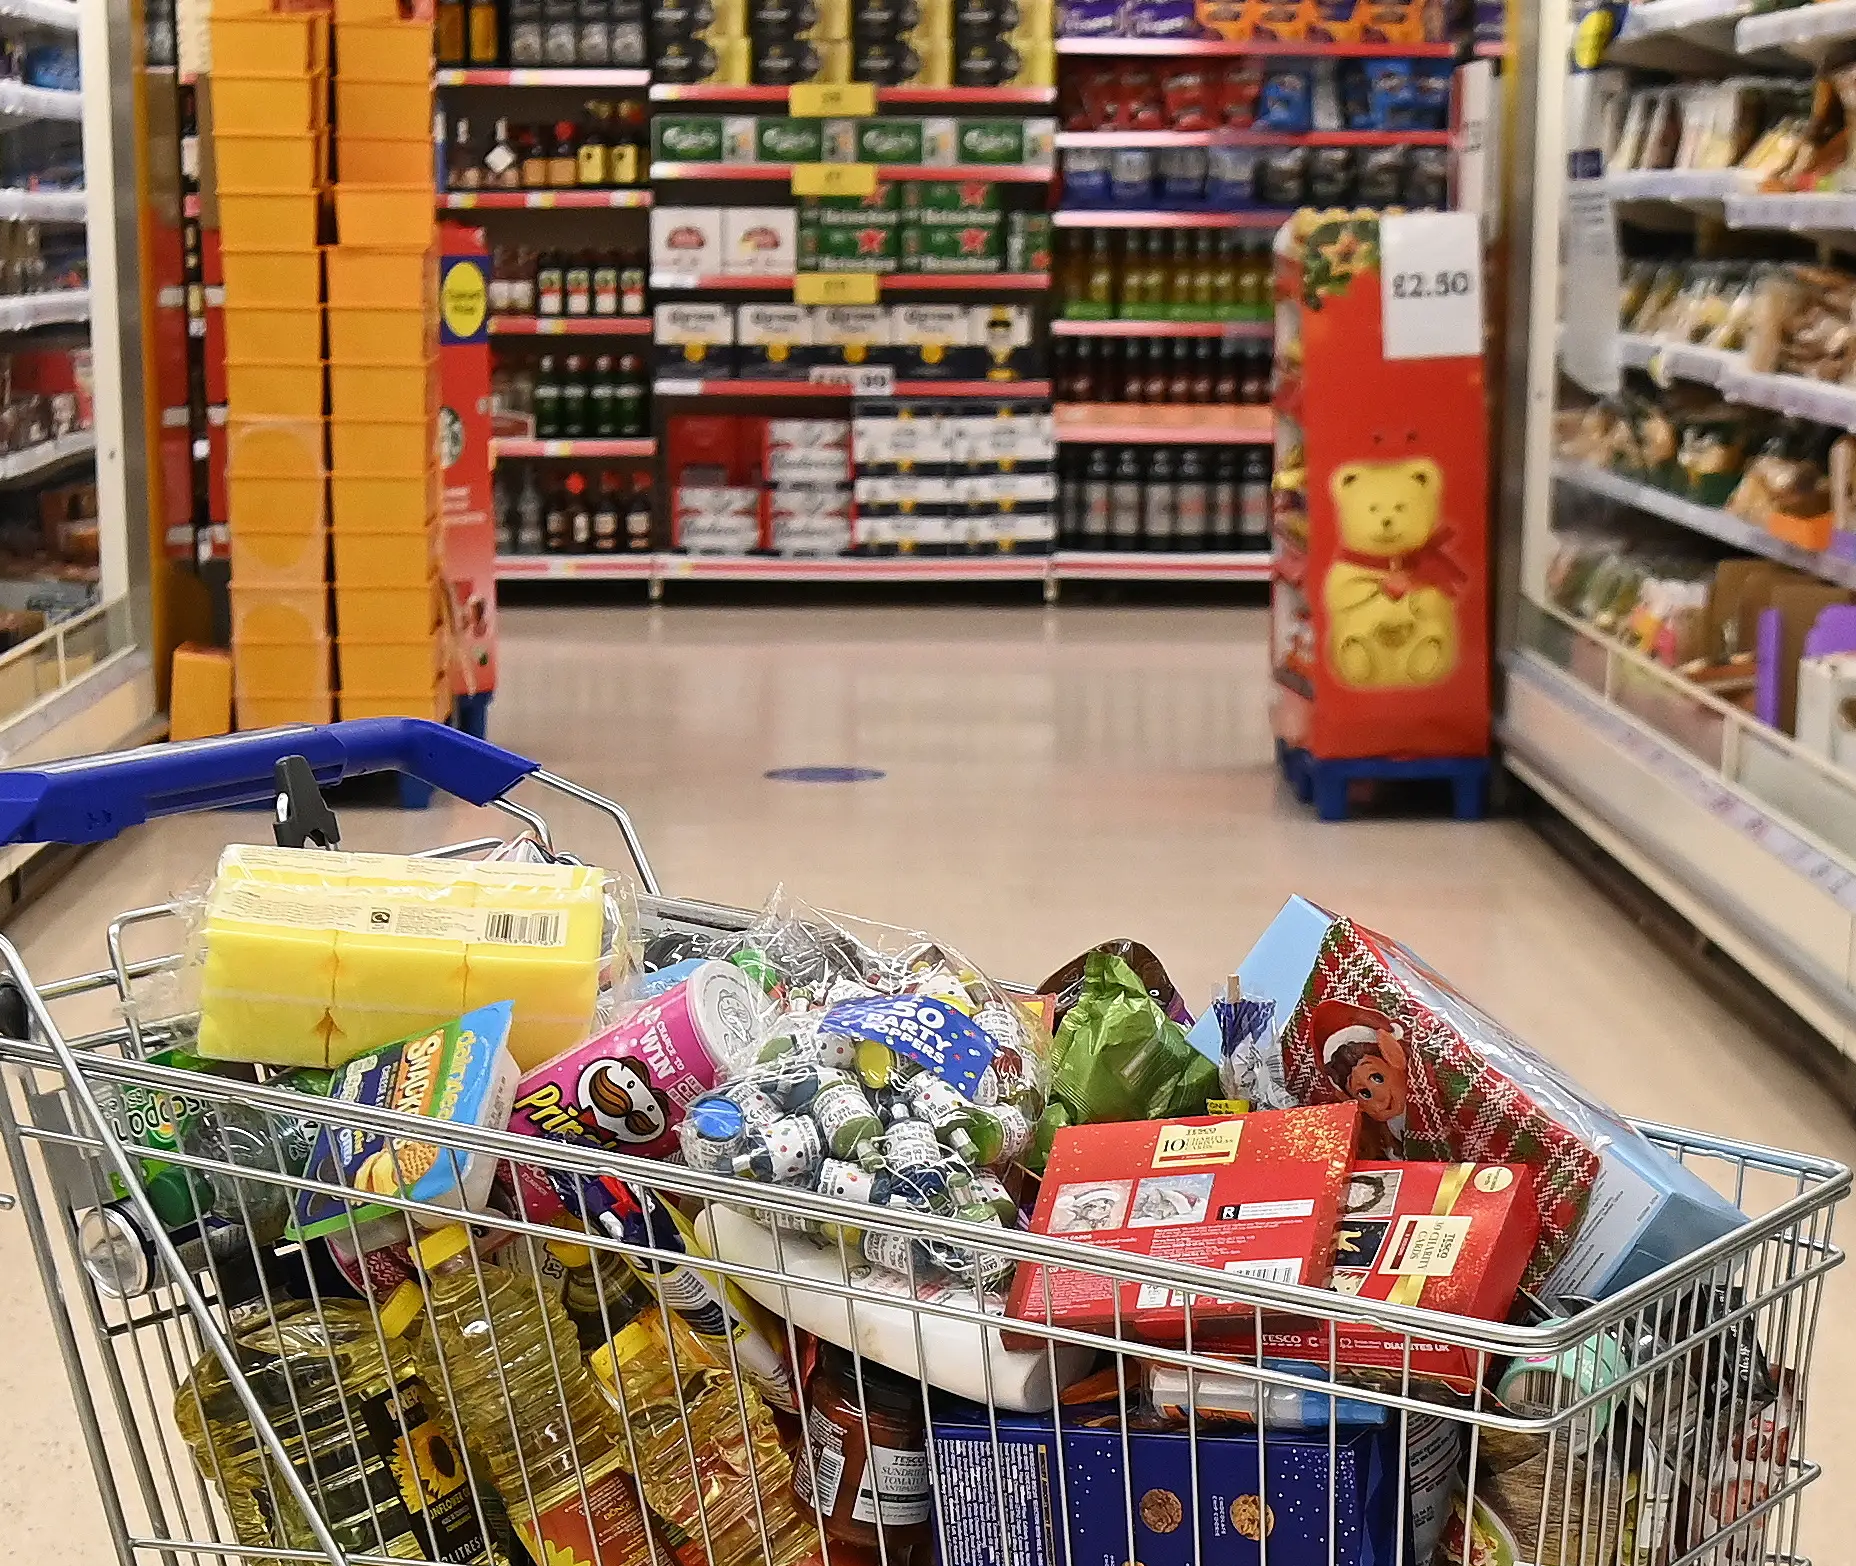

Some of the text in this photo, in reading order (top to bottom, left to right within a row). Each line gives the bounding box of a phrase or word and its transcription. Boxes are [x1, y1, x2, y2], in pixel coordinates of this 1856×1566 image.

[1392, 270, 1471, 300] £2.50
[893, 996, 945, 1031] 50
[656, 1020, 686, 1071] CHANCE TO
[860, 1020, 945, 1066] POPPERS
[865, 1010, 952, 1053] PARTY
[640, 1026, 677, 1080] WIN
[514, 1084, 618, 1149] Prin
[1162, 1138, 1186, 1153] 10
[1221, 1206, 1235, 1219] R
[1409, 1230, 1428, 1261] CARDS
[1417, 1232, 1439, 1271] CHARITY
[1437, 1232, 1456, 1260] TESCO
[1262, 1332, 1302, 1347] TESCO
[881, 1466, 925, 1477] SUNDRIE
[892, 1455, 925, 1466] TESCO
[449, 1536, 482, 1563] LITRES
